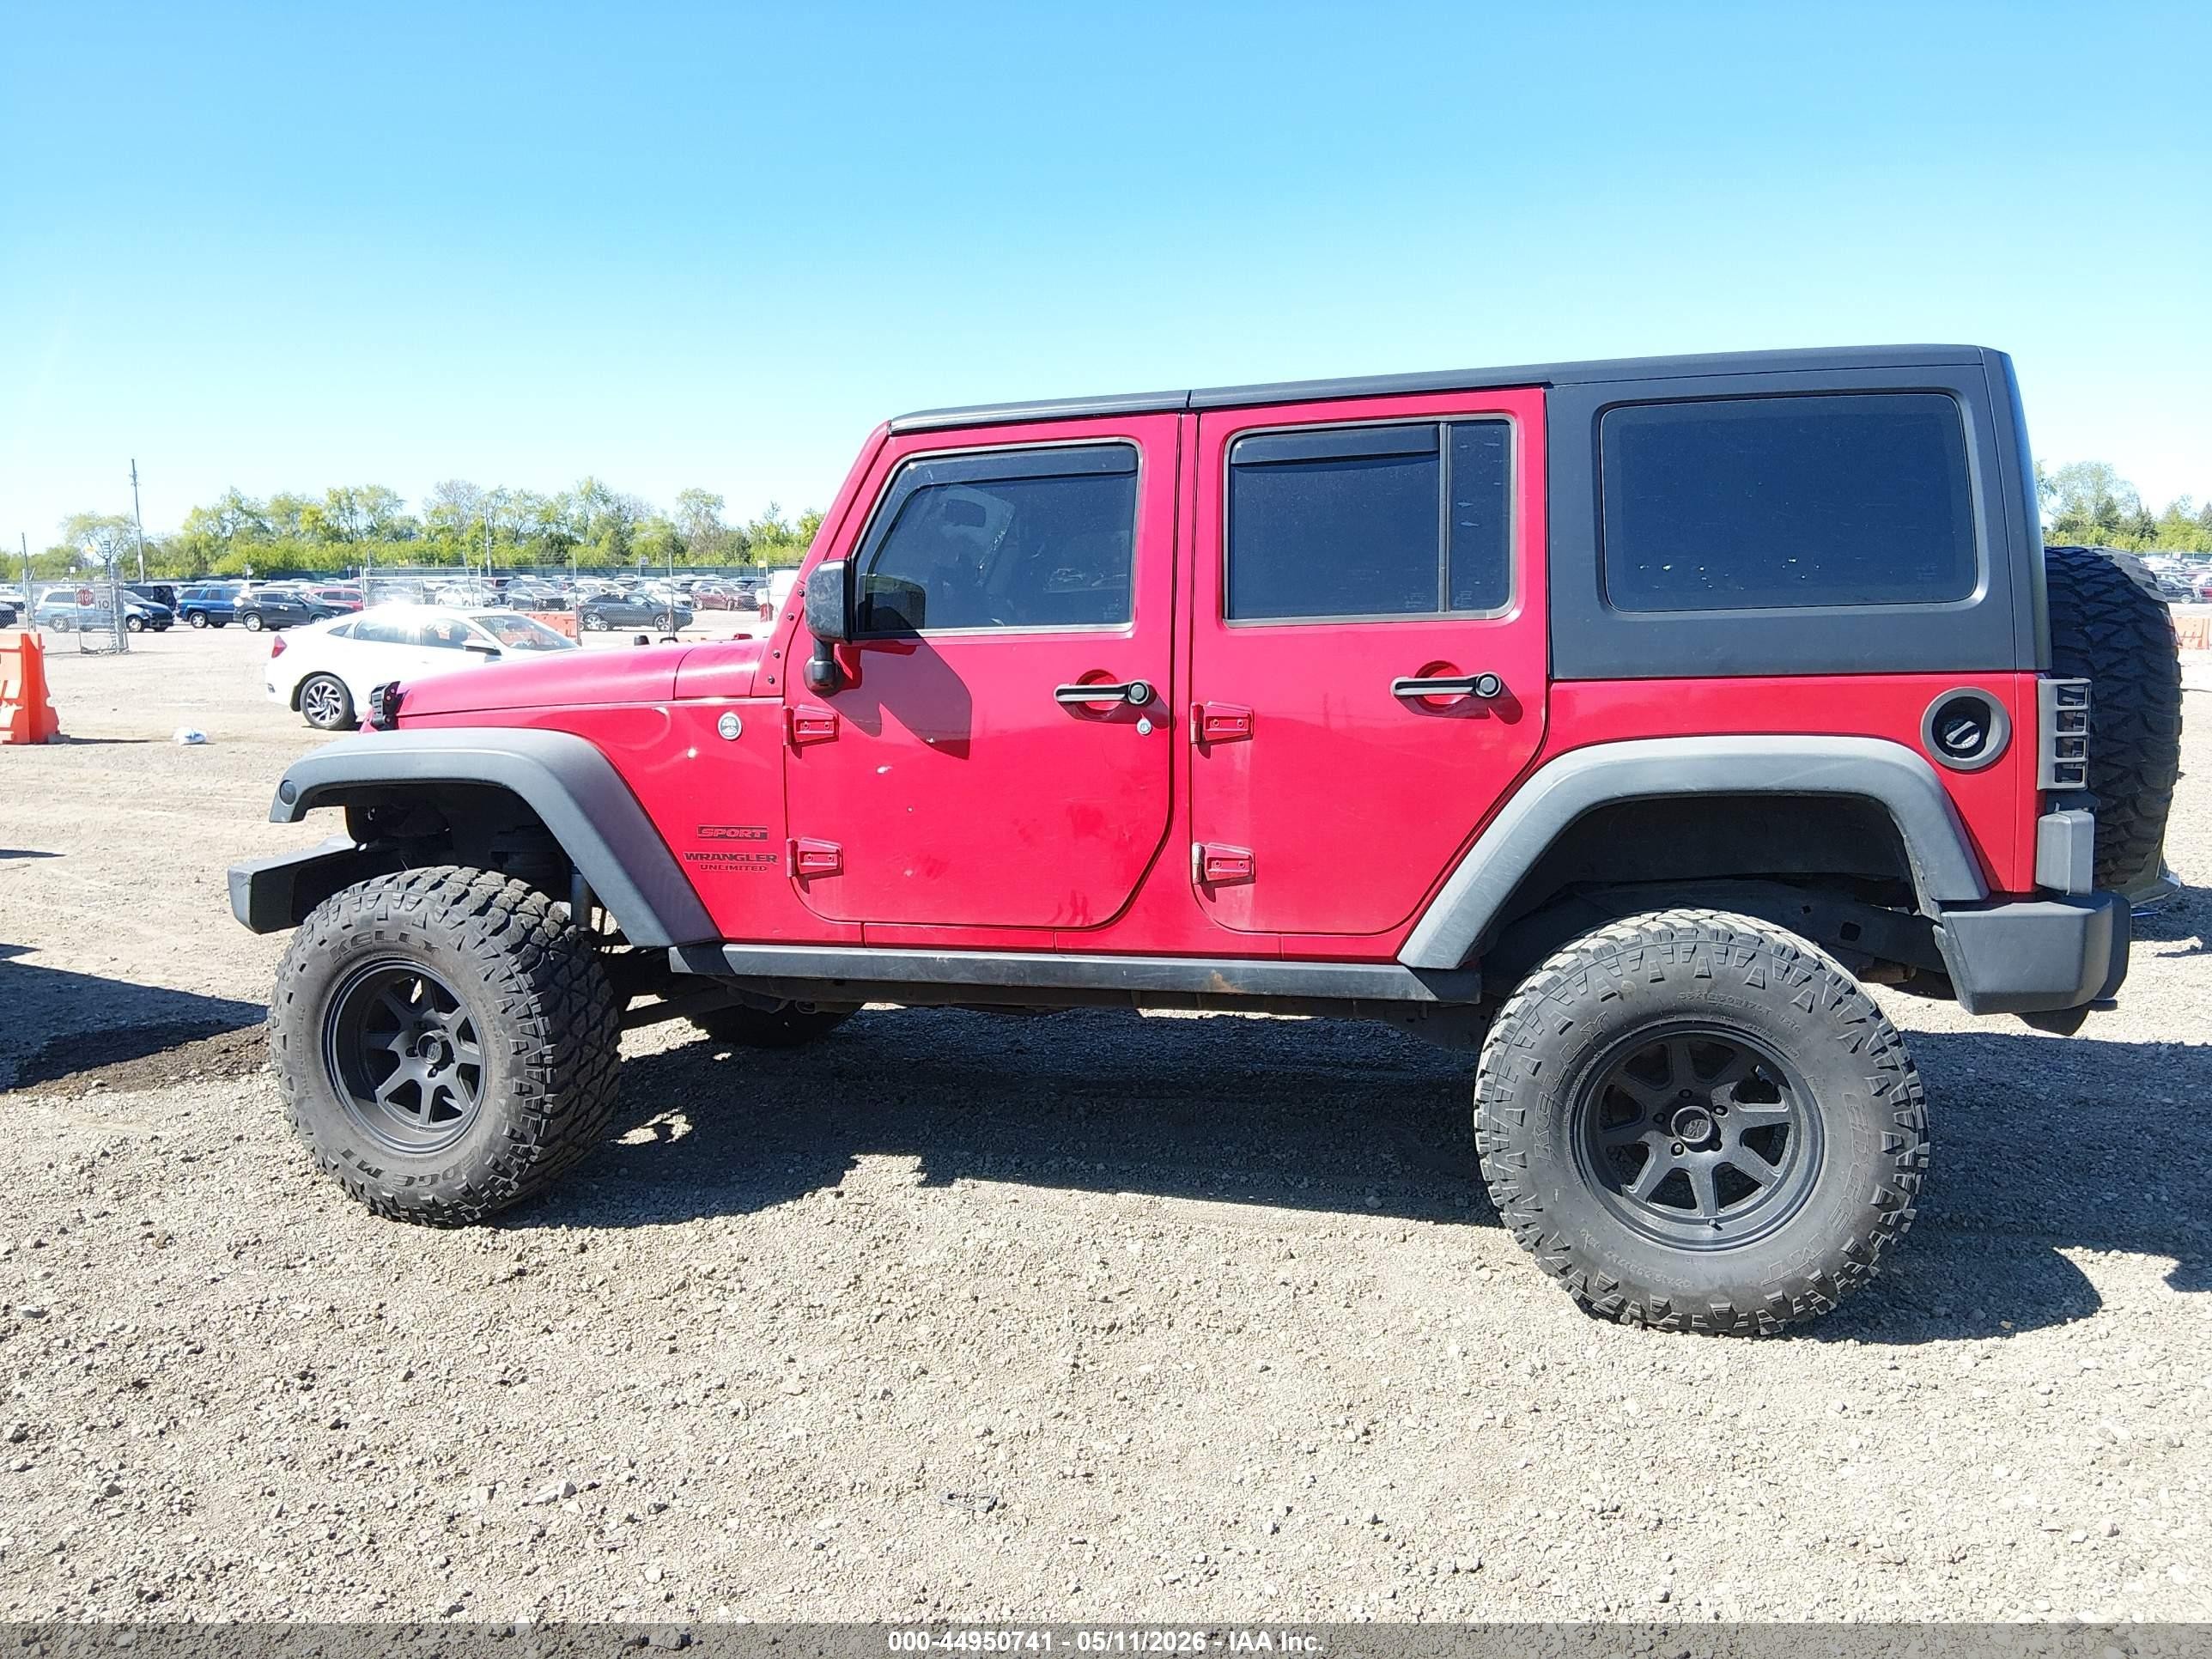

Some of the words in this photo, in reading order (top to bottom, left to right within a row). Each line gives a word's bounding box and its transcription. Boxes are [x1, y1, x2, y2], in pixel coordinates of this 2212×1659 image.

[98, 600, 109, 609] 10
[698, 827, 767, 838] SPORT
[684, 852, 777, 862] WRANGLER
[330, 929, 440, 963] KELLY
[1534, 1011, 1607, 1161] KELLY
[336, 1147, 386, 1180] MT
[392, 1146, 480, 1188] EDGE
[1828, 1093, 1869, 1232] EDGE
[1761, 1233, 1826, 1285] MT
